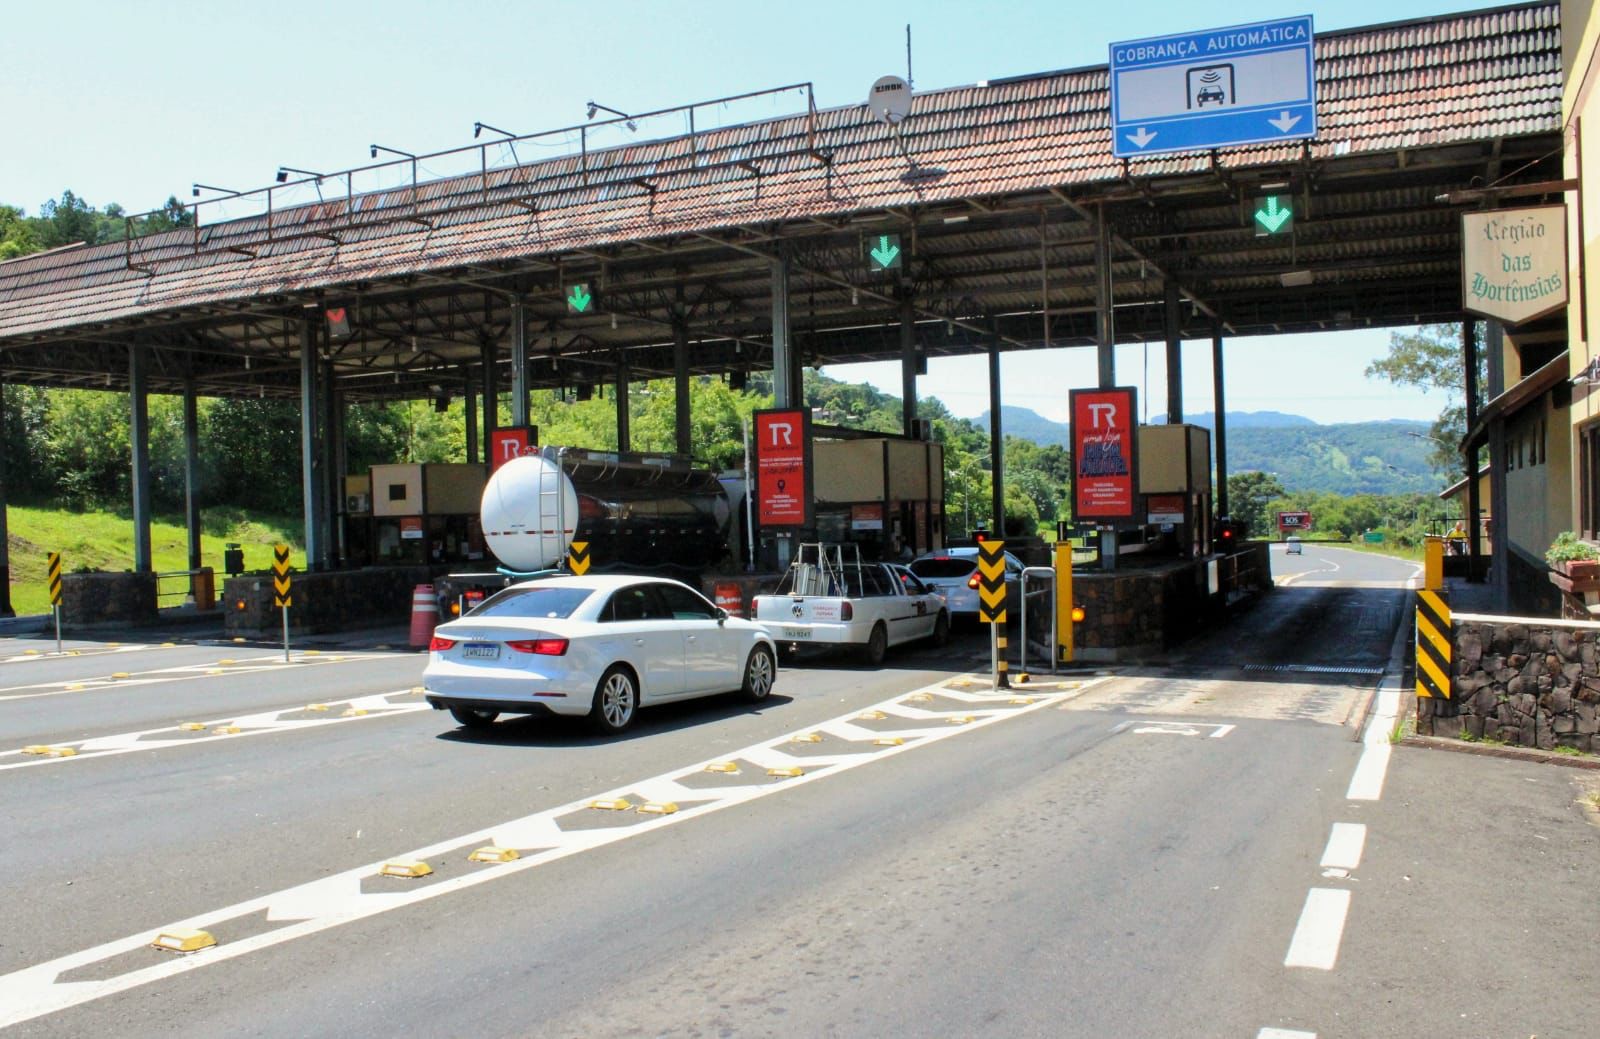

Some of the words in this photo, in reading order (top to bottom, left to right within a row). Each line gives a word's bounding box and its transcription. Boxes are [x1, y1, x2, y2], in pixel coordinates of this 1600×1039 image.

[1116, 41, 1199, 63] COBRANÇA
[1207, 25, 1306, 50] AUTOMÁTICA
[1502, 252, 1531, 272] das
[1472, 270, 1562, 302] Hortênsias
[1088, 403, 1117, 428] TR
[768, 423, 793, 446] TR
[1285, 516, 1299, 524] SOS
